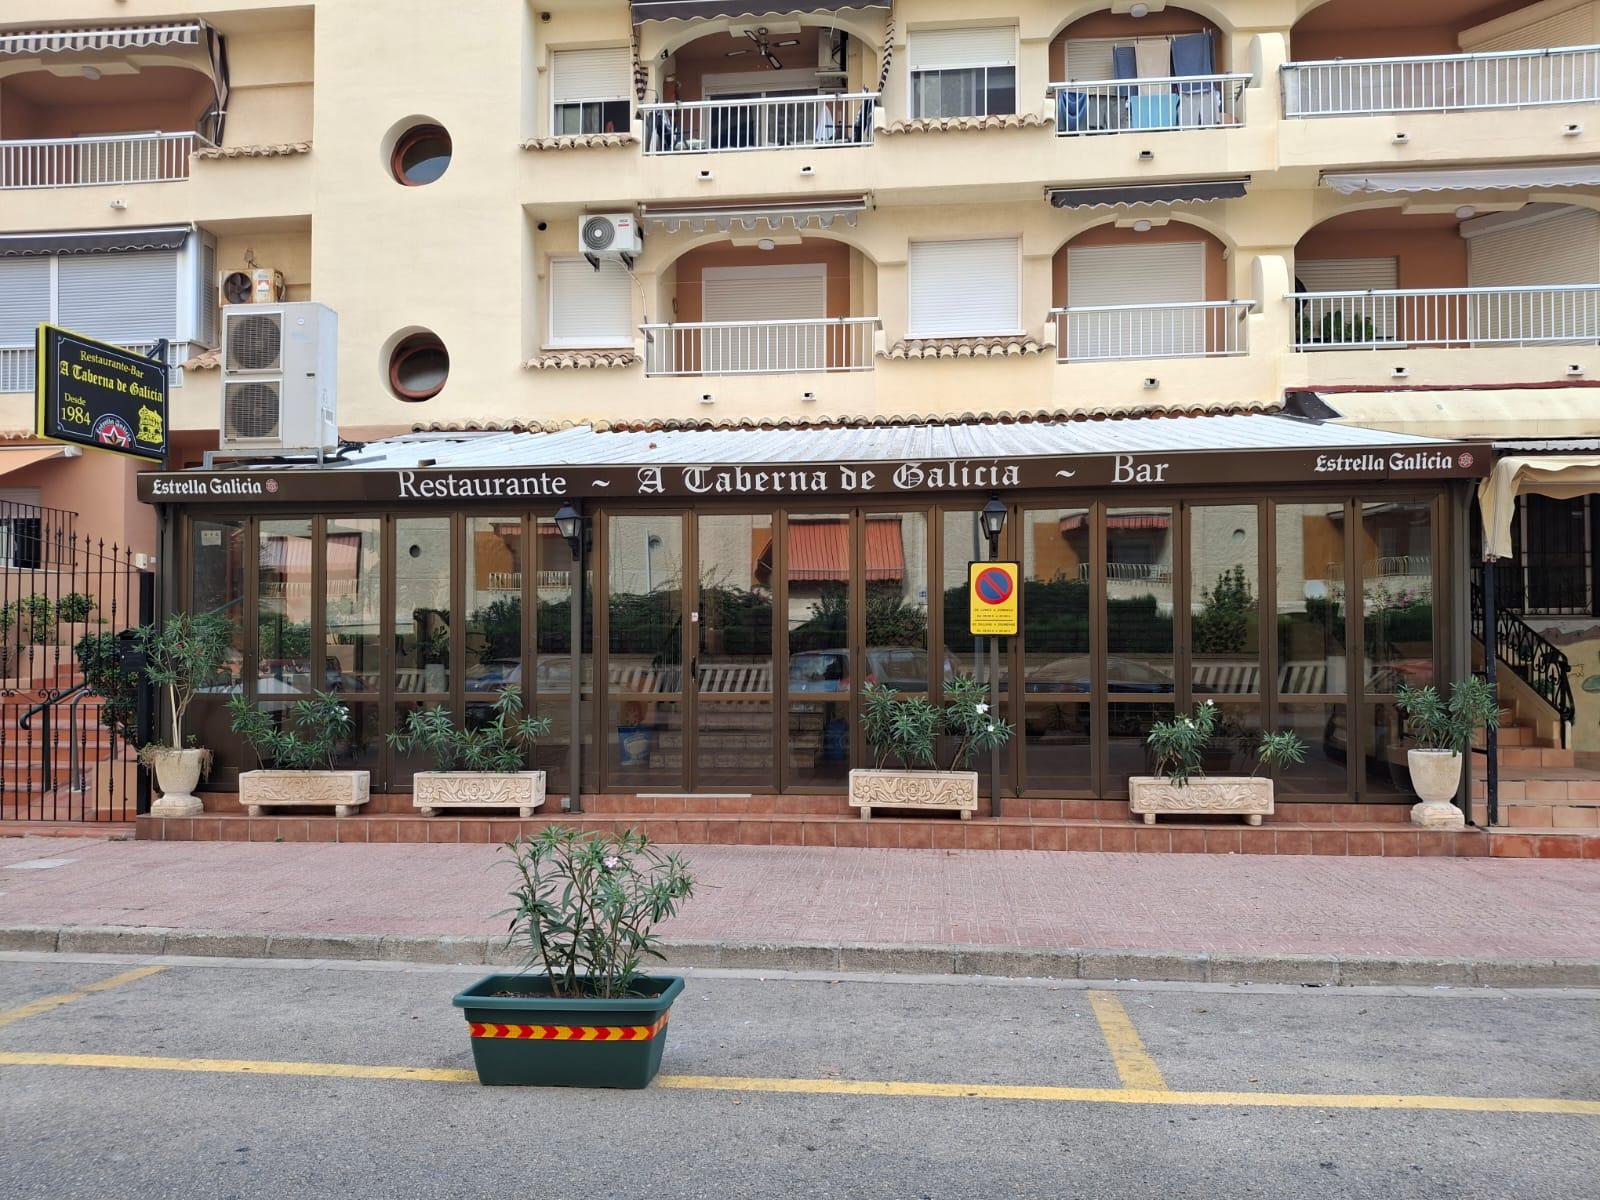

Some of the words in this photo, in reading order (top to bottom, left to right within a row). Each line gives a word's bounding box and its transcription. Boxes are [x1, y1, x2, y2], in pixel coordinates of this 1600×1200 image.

[80, 350, 145, 379] Restaurante-Bar
[60, 360, 70, 376] A
[72, 364, 114, 391] Taberna
[116, 378, 127, 393] de
[129, 382, 163, 403] Galicia
[64, 392, 87, 406] Desde
[61, 406, 91, 426] 1984
[1314, 454, 1384, 472] Estrella
[1389, 452, 1452, 470] Galicia
[398, 471, 567, 497] Restaurante
[637, 466, 666, 494] A
[682, 466, 828, 493] Taberna
[839, 465, 876, 491] de
[892, 460, 1022, 489] Galicia
[1111, 455, 1169, 483] Bar
[152, 479, 207, 495] Estrella
[209, 478, 262, 494] Galicia
